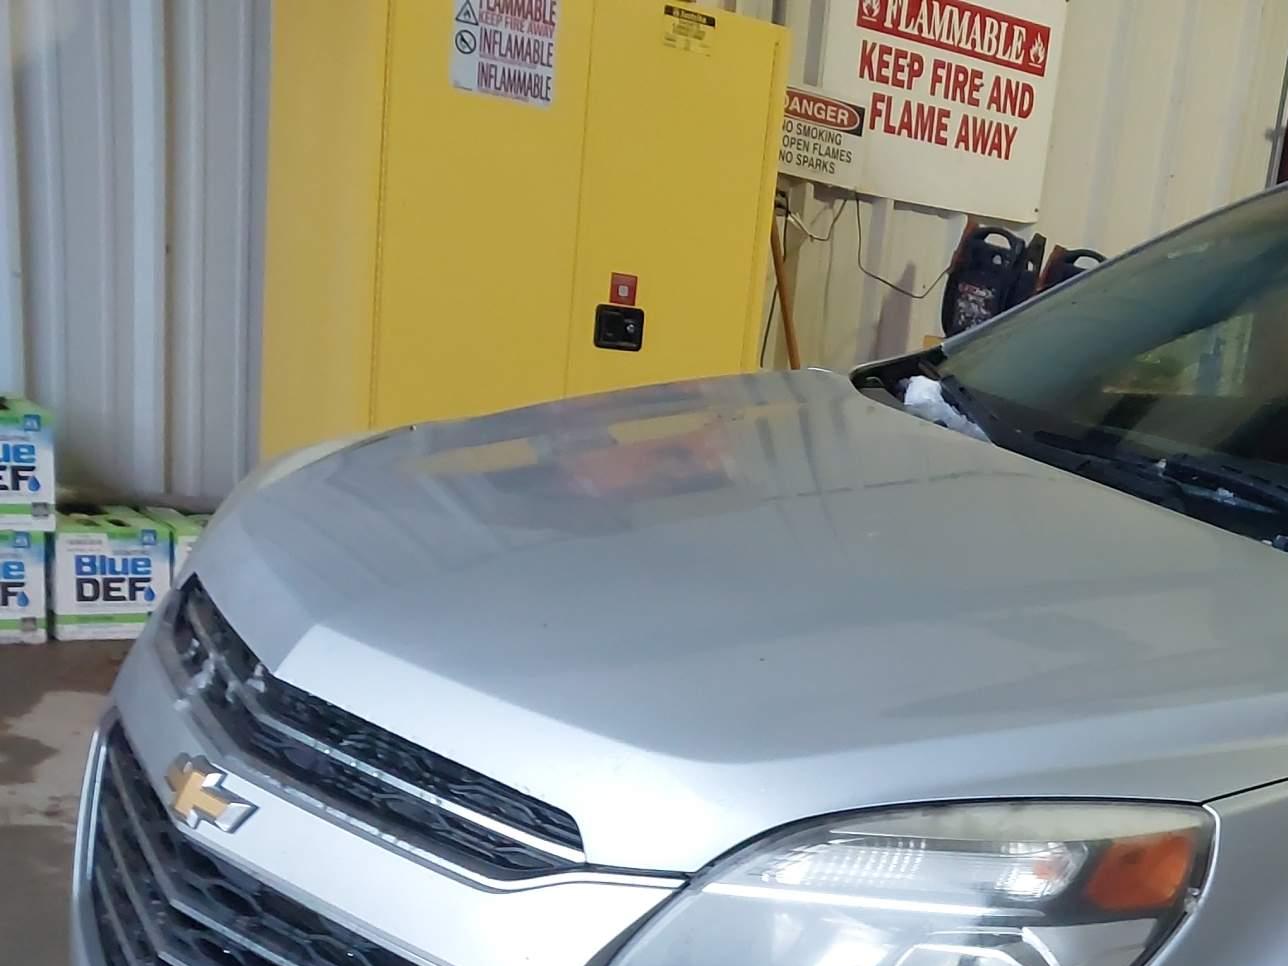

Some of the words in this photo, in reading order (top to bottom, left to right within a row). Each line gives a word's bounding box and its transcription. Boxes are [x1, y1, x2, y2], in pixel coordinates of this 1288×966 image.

[505, 15, 525, 33] FIRE
[527, 20, 555, 39] AWAY
[884, 0, 1027, 64] FLAMMABLE
[479, 25, 554, 68] INFLAMABLE
[477, 60, 553, 102] INFLAMMABLE
[859, 39, 925, 91] KEEP
[929, 58, 984, 108] FIRE
[986, 75, 1035, 120] AND
[796, 122, 843, 146] SMOKING
[869, 92, 951, 147] FLAME
[954, 113, 1018, 161] AWAY
[778, 149, 794, 164] NO
[795, 153, 836, 175] SPARKS
[782, 134, 810, 153] OPEN
[812, 142, 852, 164] FLAMES
[75, 554, 153, 577] Blue
[76, 577, 153, 603] DEF
